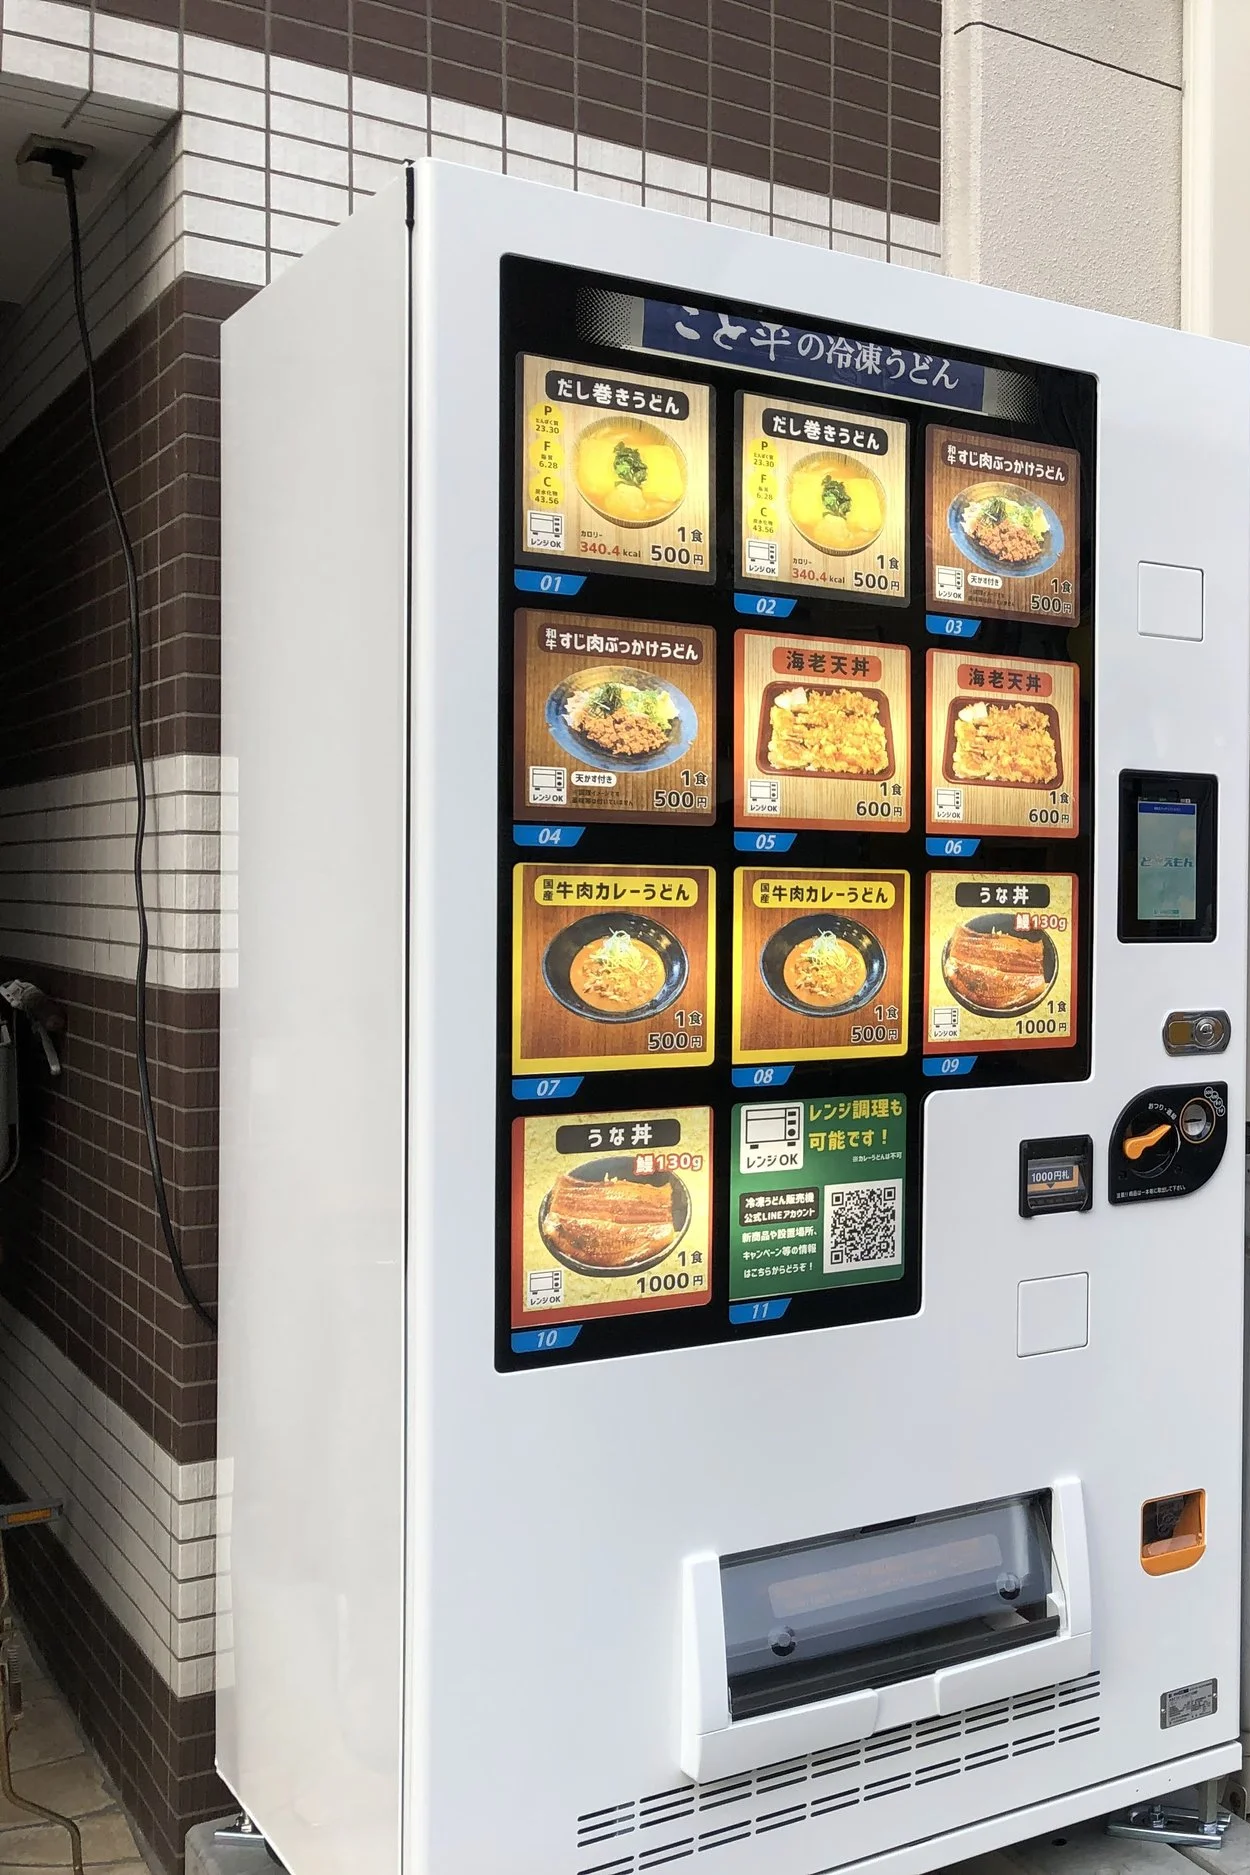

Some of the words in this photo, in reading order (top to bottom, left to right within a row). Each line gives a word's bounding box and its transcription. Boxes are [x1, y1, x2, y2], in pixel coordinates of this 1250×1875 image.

[557, 378, 680, 415] だし巻きうどん
[544, 406, 553, 416] P
[535, 424, 560, 434] 23.30
[772, 415, 881, 451] だし巻きうどん
[543, 441, 551, 451] F
[761, 441, 769, 450] P
[539, 460, 558, 469] 6.28
[753, 458, 775, 468] 23.30
[543, 476, 552, 487] C
[760, 474, 767, 484] F
[534, 495, 560, 505] 43.56
[760, 507, 768, 517] C
[580, 530, 603, 539] カロリー
[752, 524, 775, 534] 43.56
[579, 541, 621, 557] 340.4
[540, 574, 563, 592] 01
[792, 568, 828, 583] 340.4
[756, 598, 777, 615] 02
[945, 619, 963, 635] 03
[786, 650, 870, 677] 海老天丼
[968, 667, 1042, 693] 海老天丼
[575, 773, 613, 785] 天かす付き
[538, 828, 561, 845] 04
[755, 834, 777, 850] 05
[944, 839, 963, 855] 06
[979, 885, 1030, 905] うな丼
[941, 1058, 960, 1074] 09
[753, 1068, 775, 1085] 08
[536, 1080, 561, 1097] 07
[808, 1098, 903, 1122] レンジ調理も
[587, 1123, 653, 1148] うな丼
[1031, 1169, 1071, 1183] 1000円札
[744, 1192, 815, 1209] 冷凍うどん販売機
[743, 1208, 816, 1224] 公式LINEアカウント
[742, 1243, 817, 1261] キャンペーン等の情報
[743, 1262, 814, 1279] はこちらからどうぞ！
[752, 1302, 770, 1320] 11
[536, 1329, 558, 1349] 10
